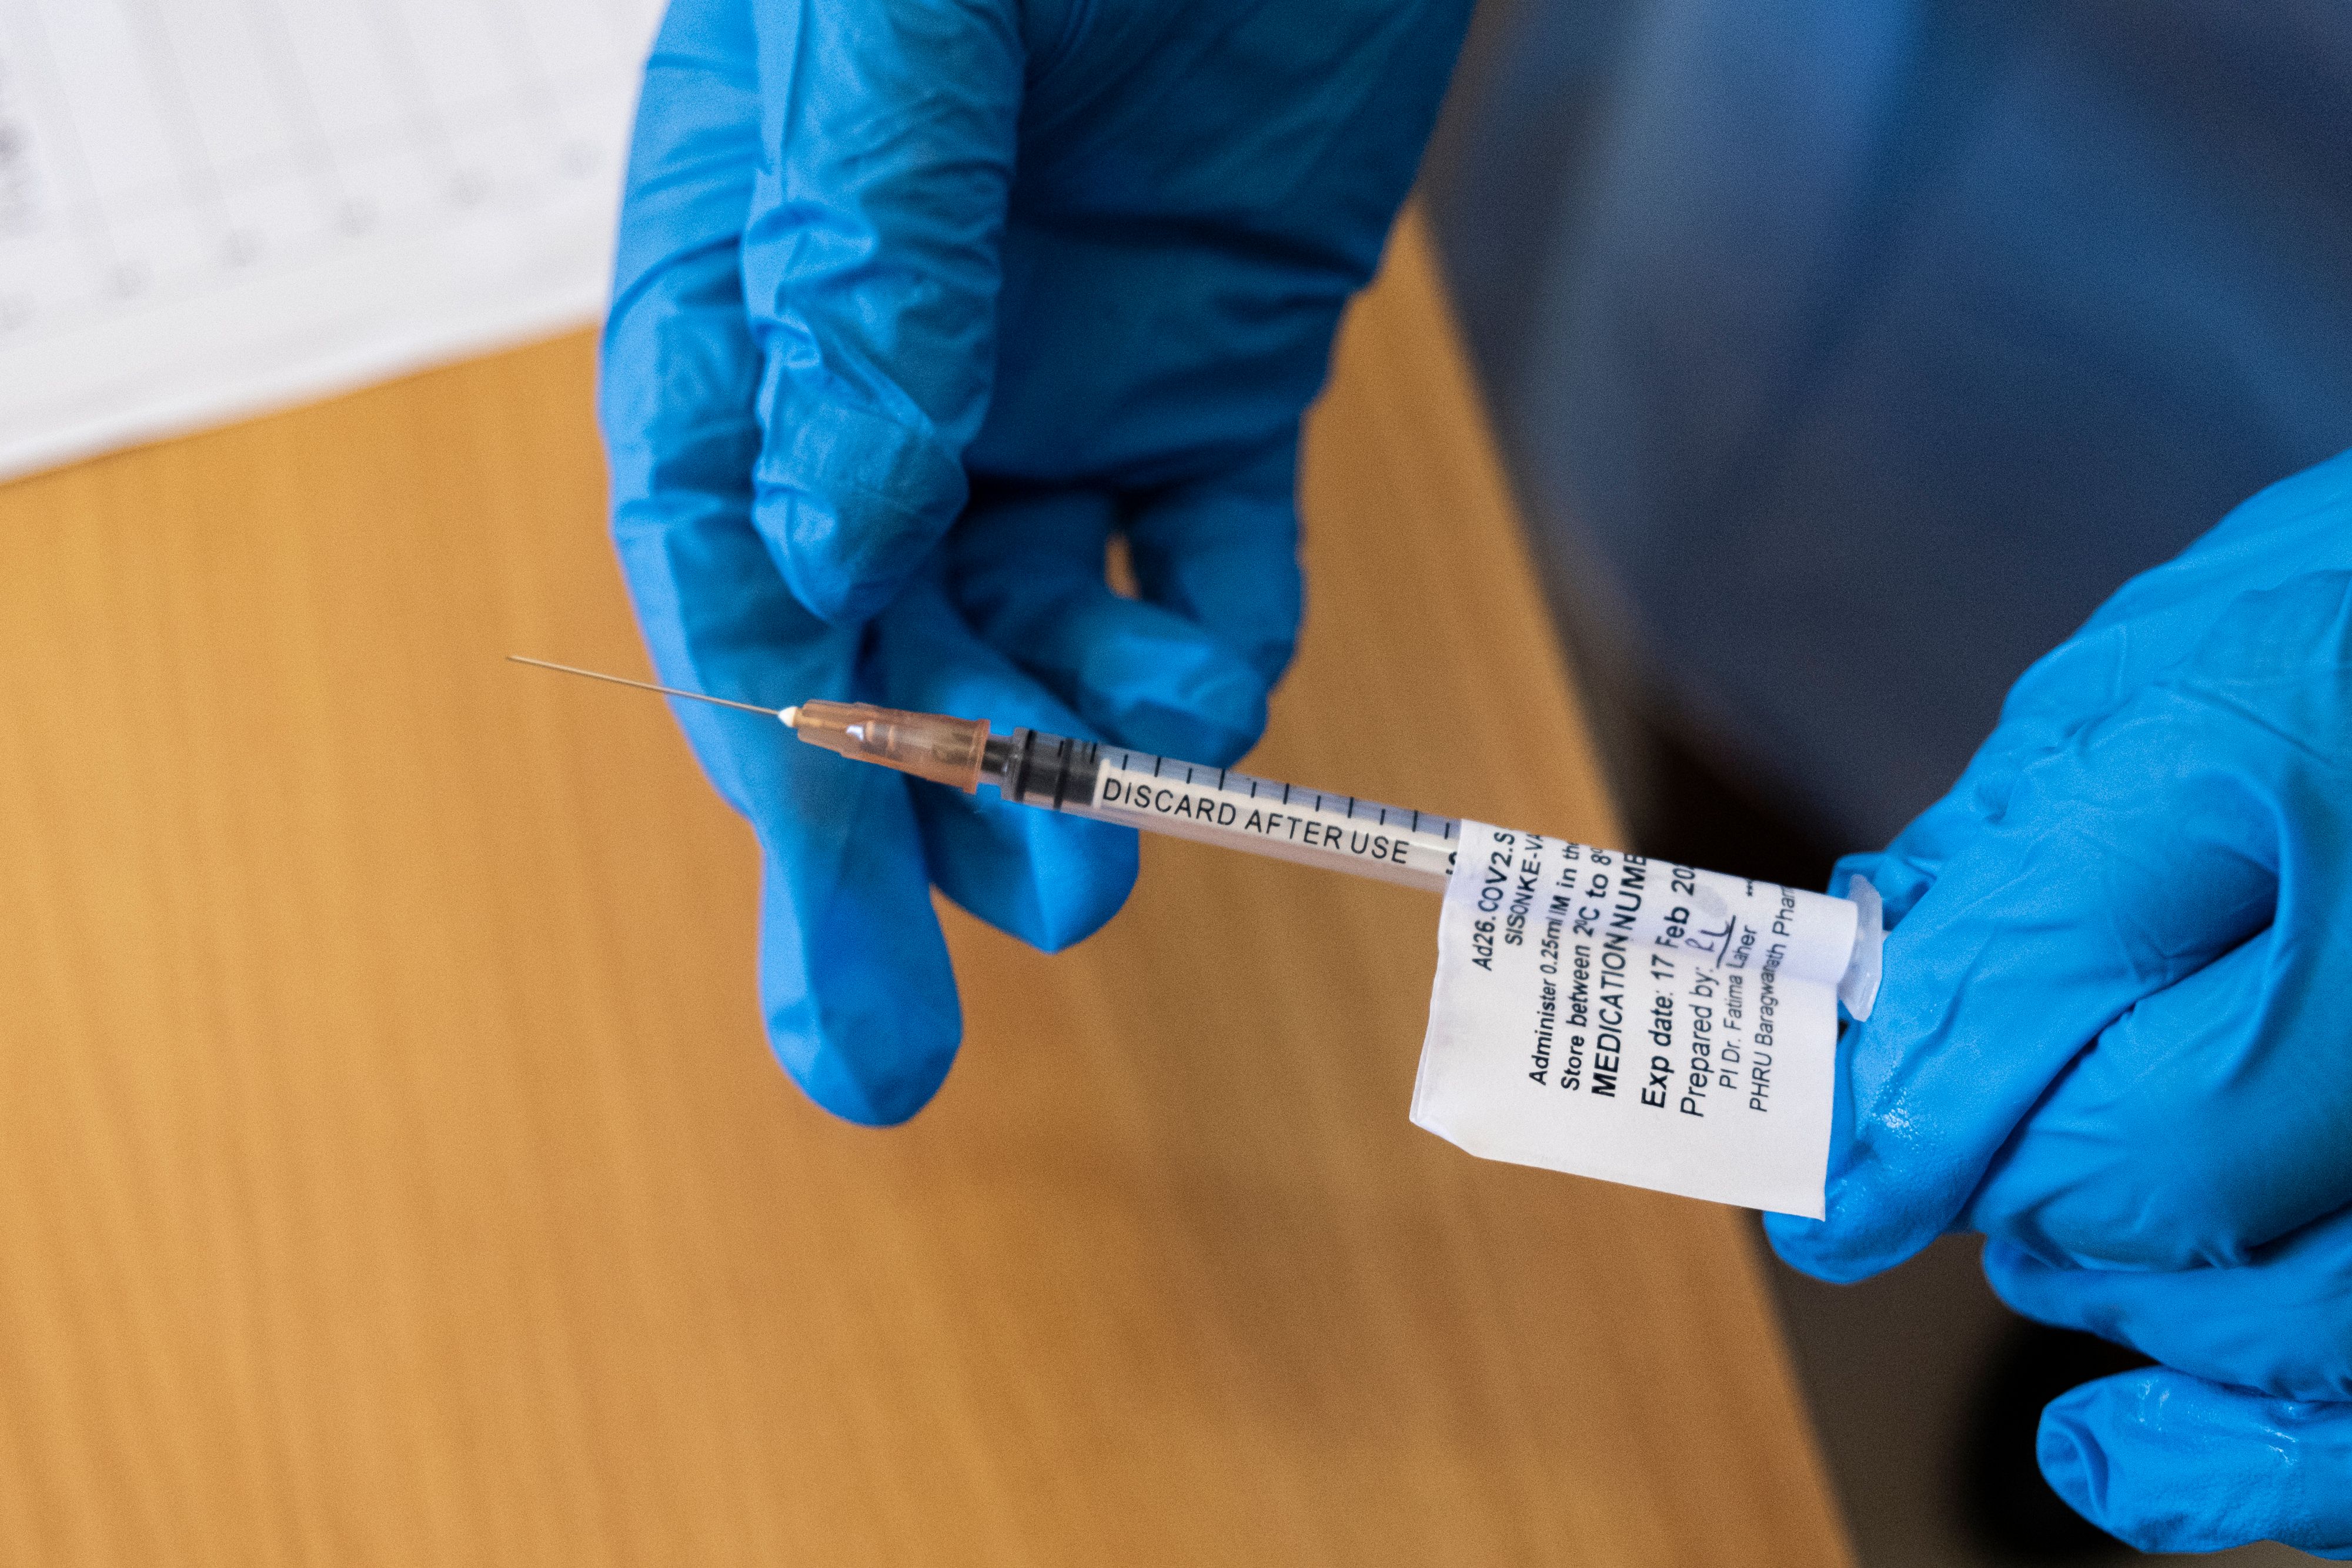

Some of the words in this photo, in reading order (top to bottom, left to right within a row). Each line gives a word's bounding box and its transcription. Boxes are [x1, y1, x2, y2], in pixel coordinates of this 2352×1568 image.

[1102, 777, 1237, 826] DISCARD
[1245, 809, 1343, 850] AFTER
[1352, 832, 1411, 865] USE
[1472, 832, 1515, 971] Ad26.COV2.S
[1556, 867, 1578, 888] in
[1585, 874, 1609, 898] to
[1671, 866, 1696, 897] 20
[1549, 895, 1571, 917] IM
[1655, 906, 1690, 949] Feb
[1540, 917, 1563, 974] 0.25ml
[1651, 954, 1675, 979] 17
[1726, 925, 1758, 969] Laher
[1566, 944, 1591, 1027] between
[1689, 967, 1719, 998] by:
[1723, 974, 1743, 1031] Fatima
[1529, 978, 1556, 1085] Administer
[1591, 932, 1629, 1098] MEDICATION
[1648, 990, 1674, 1047] date:
[1561, 1035, 1585, 1091] Store
[1680, 1004, 1715, 1117] Prepared
[1719, 1068, 1739, 1089] PI
[1722, 1039, 1741, 1064] Dr.
[1641, 1055, 1675, 1108] Exp
[1749, 1051, 1773, 1112] PHRU
